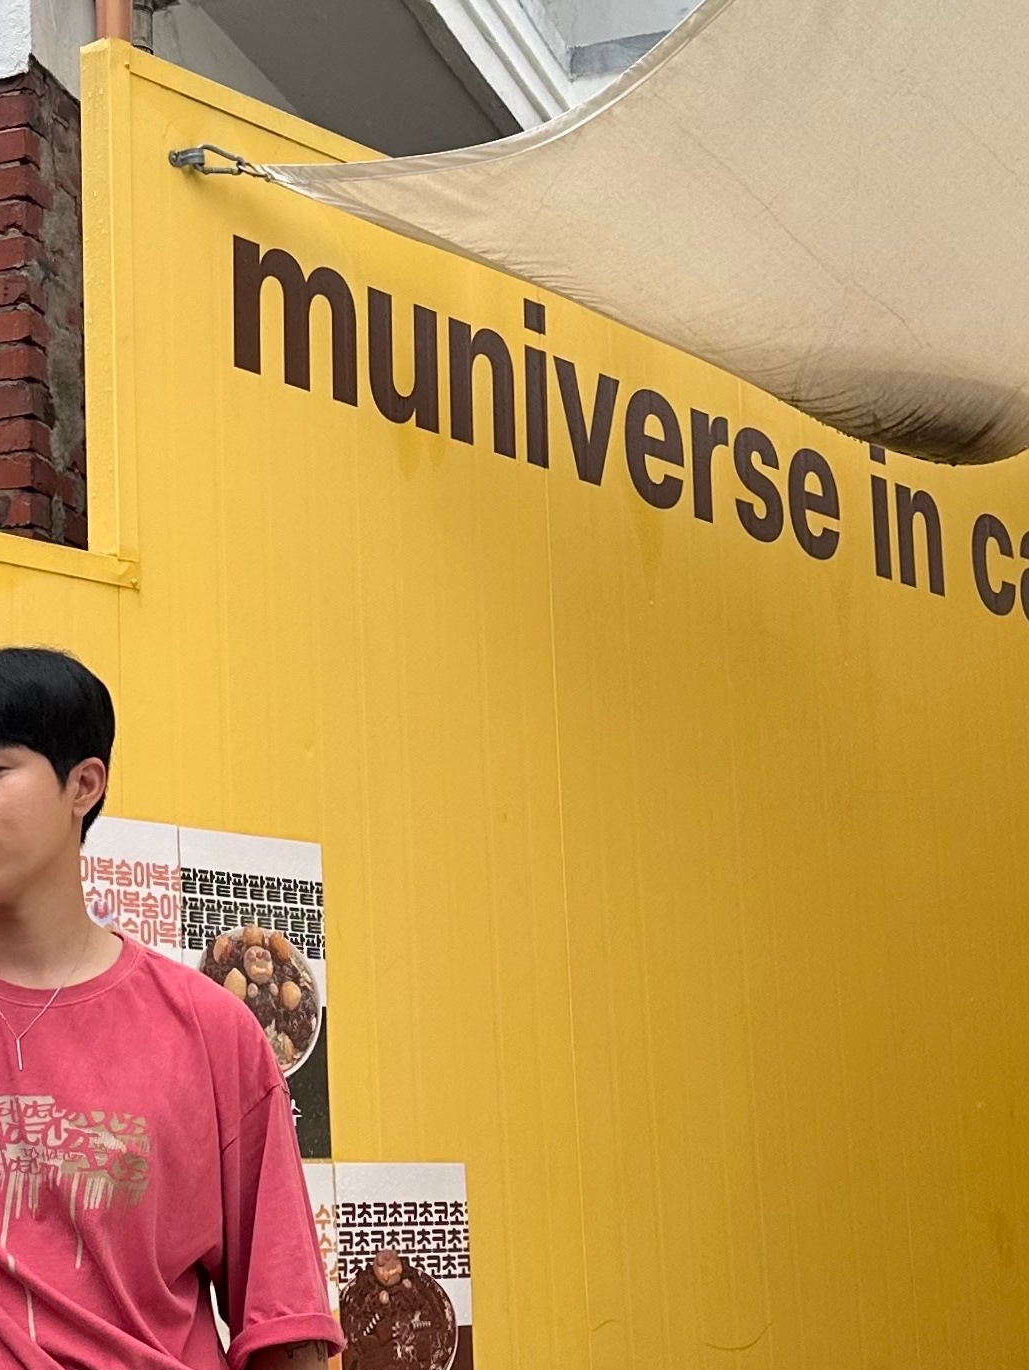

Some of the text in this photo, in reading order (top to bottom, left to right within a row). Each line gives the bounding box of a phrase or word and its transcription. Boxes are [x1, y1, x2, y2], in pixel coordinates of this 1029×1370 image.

[233, 234, 840, 561] muniverse
[869, 442, 946, 598] in
[336, 1200, 469, 1228] 코초코초코초코초
